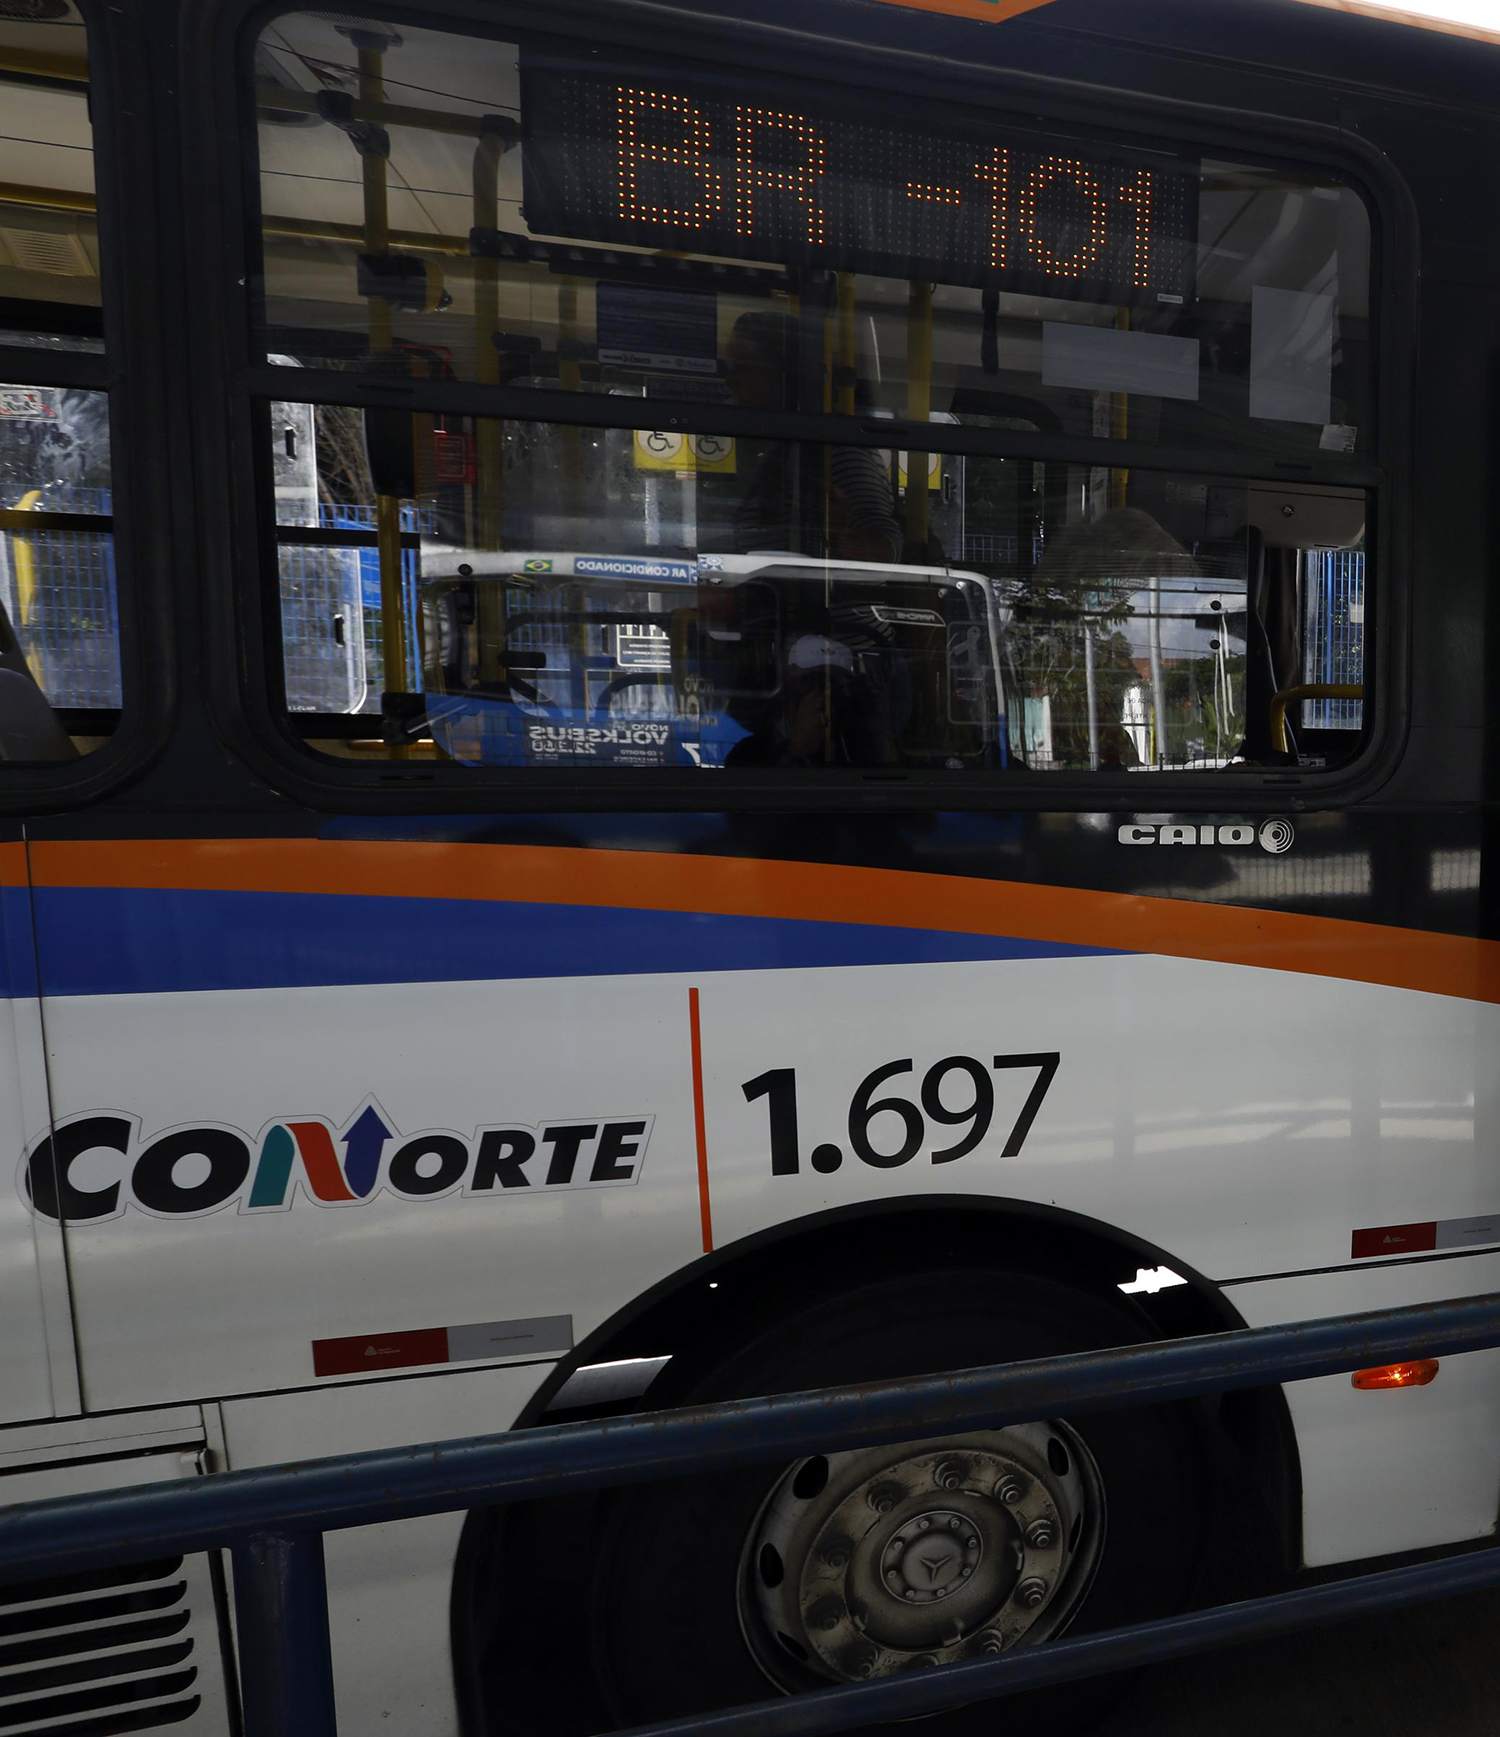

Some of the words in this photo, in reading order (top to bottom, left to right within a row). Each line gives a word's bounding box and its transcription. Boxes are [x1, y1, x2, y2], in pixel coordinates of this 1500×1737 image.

[617, 86, 824, 244] BR
[1118, 825, 1255, 845] CAIO
[25, 1105, 647, 1221] CONORTE
[740, 1051, 1061, 1177] 1.697
